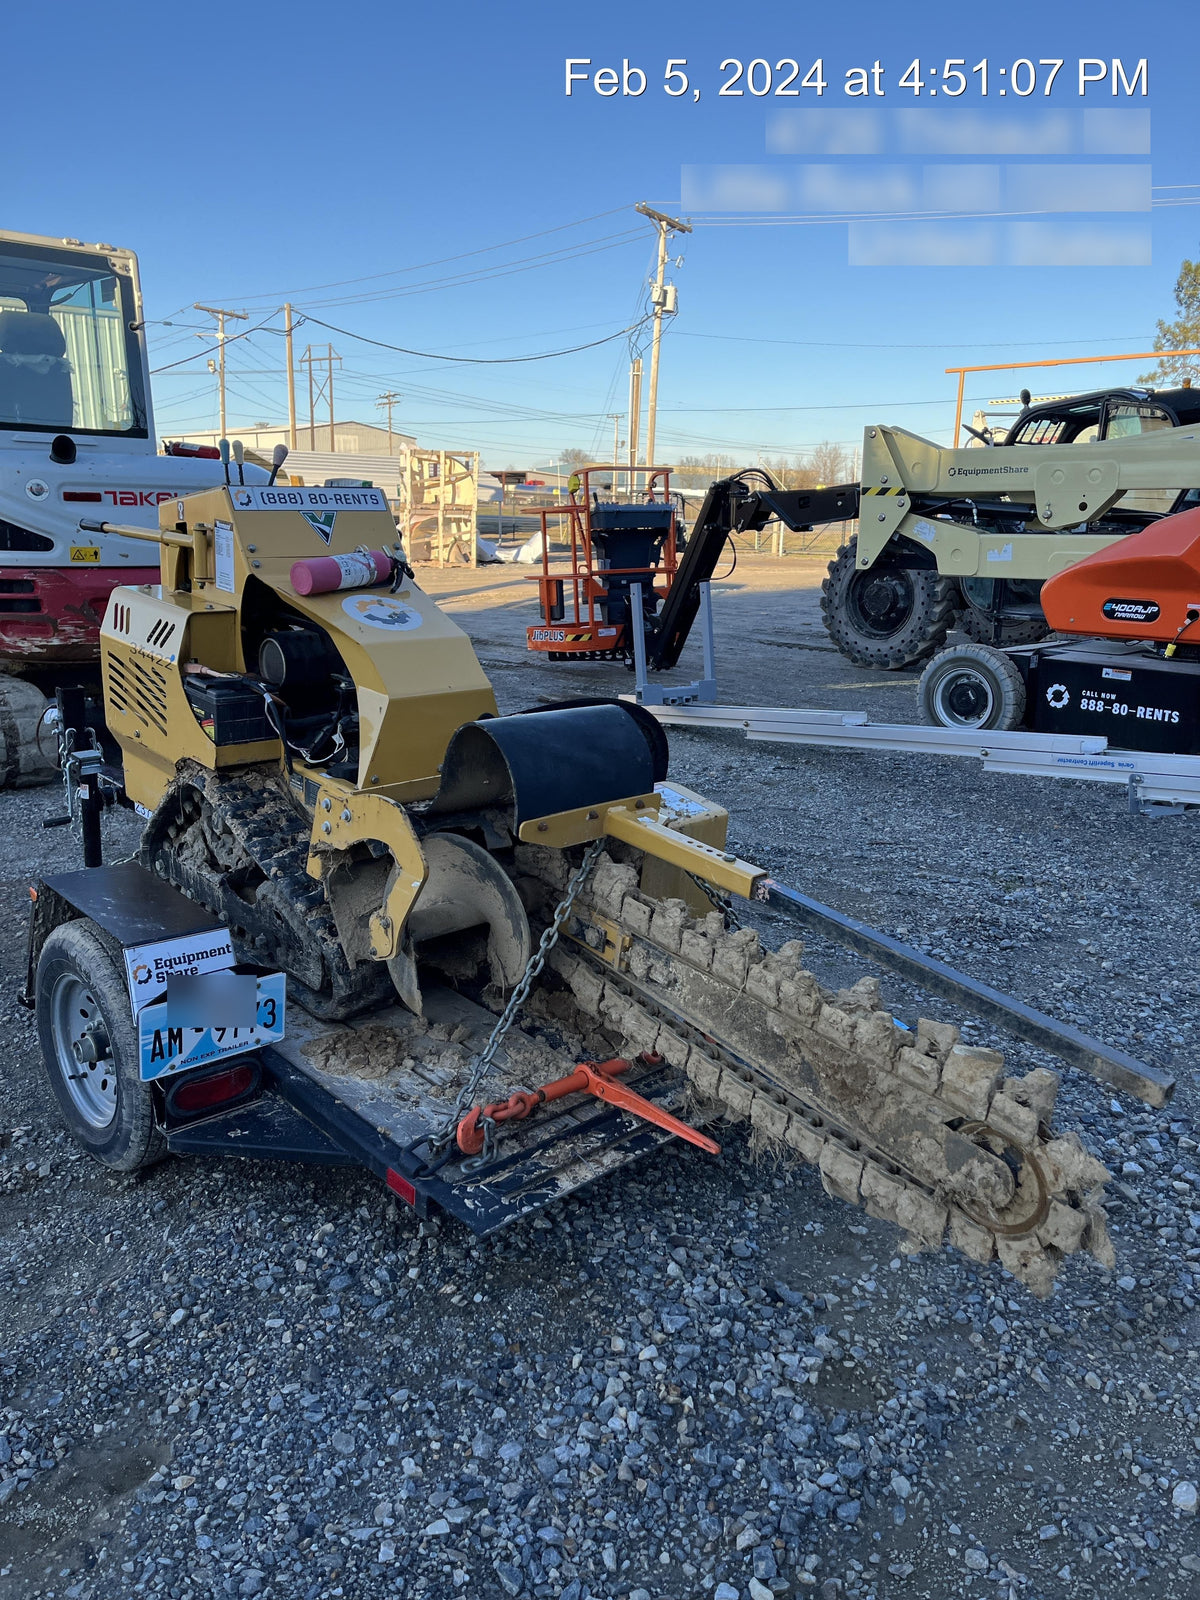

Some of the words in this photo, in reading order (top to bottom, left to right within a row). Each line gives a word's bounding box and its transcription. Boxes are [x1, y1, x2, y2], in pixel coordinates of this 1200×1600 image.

[957, 466, 1029, 476] EquipmentShare
[104, 490, 178, 507] TAKE
[260, 491, 304, 506] (888)
[308, 493, 380, 506] 80-RENTS
[1114, 611, 1146, 620] NARROW
[532, 629, 565, 642] JibPLUS
[1082, 690, 1098, 698] CALL
[1101, 692, 1117, 700] NOW
[1080, 698, 1180, 723] 888-80-RENTS
[153, 943, 232, 970] Equipment
[180, 1055, 199, 1065] NON
[200, 1050, 216, 1060] EXP
[218, 1040, 249, 1054] TRAILER
